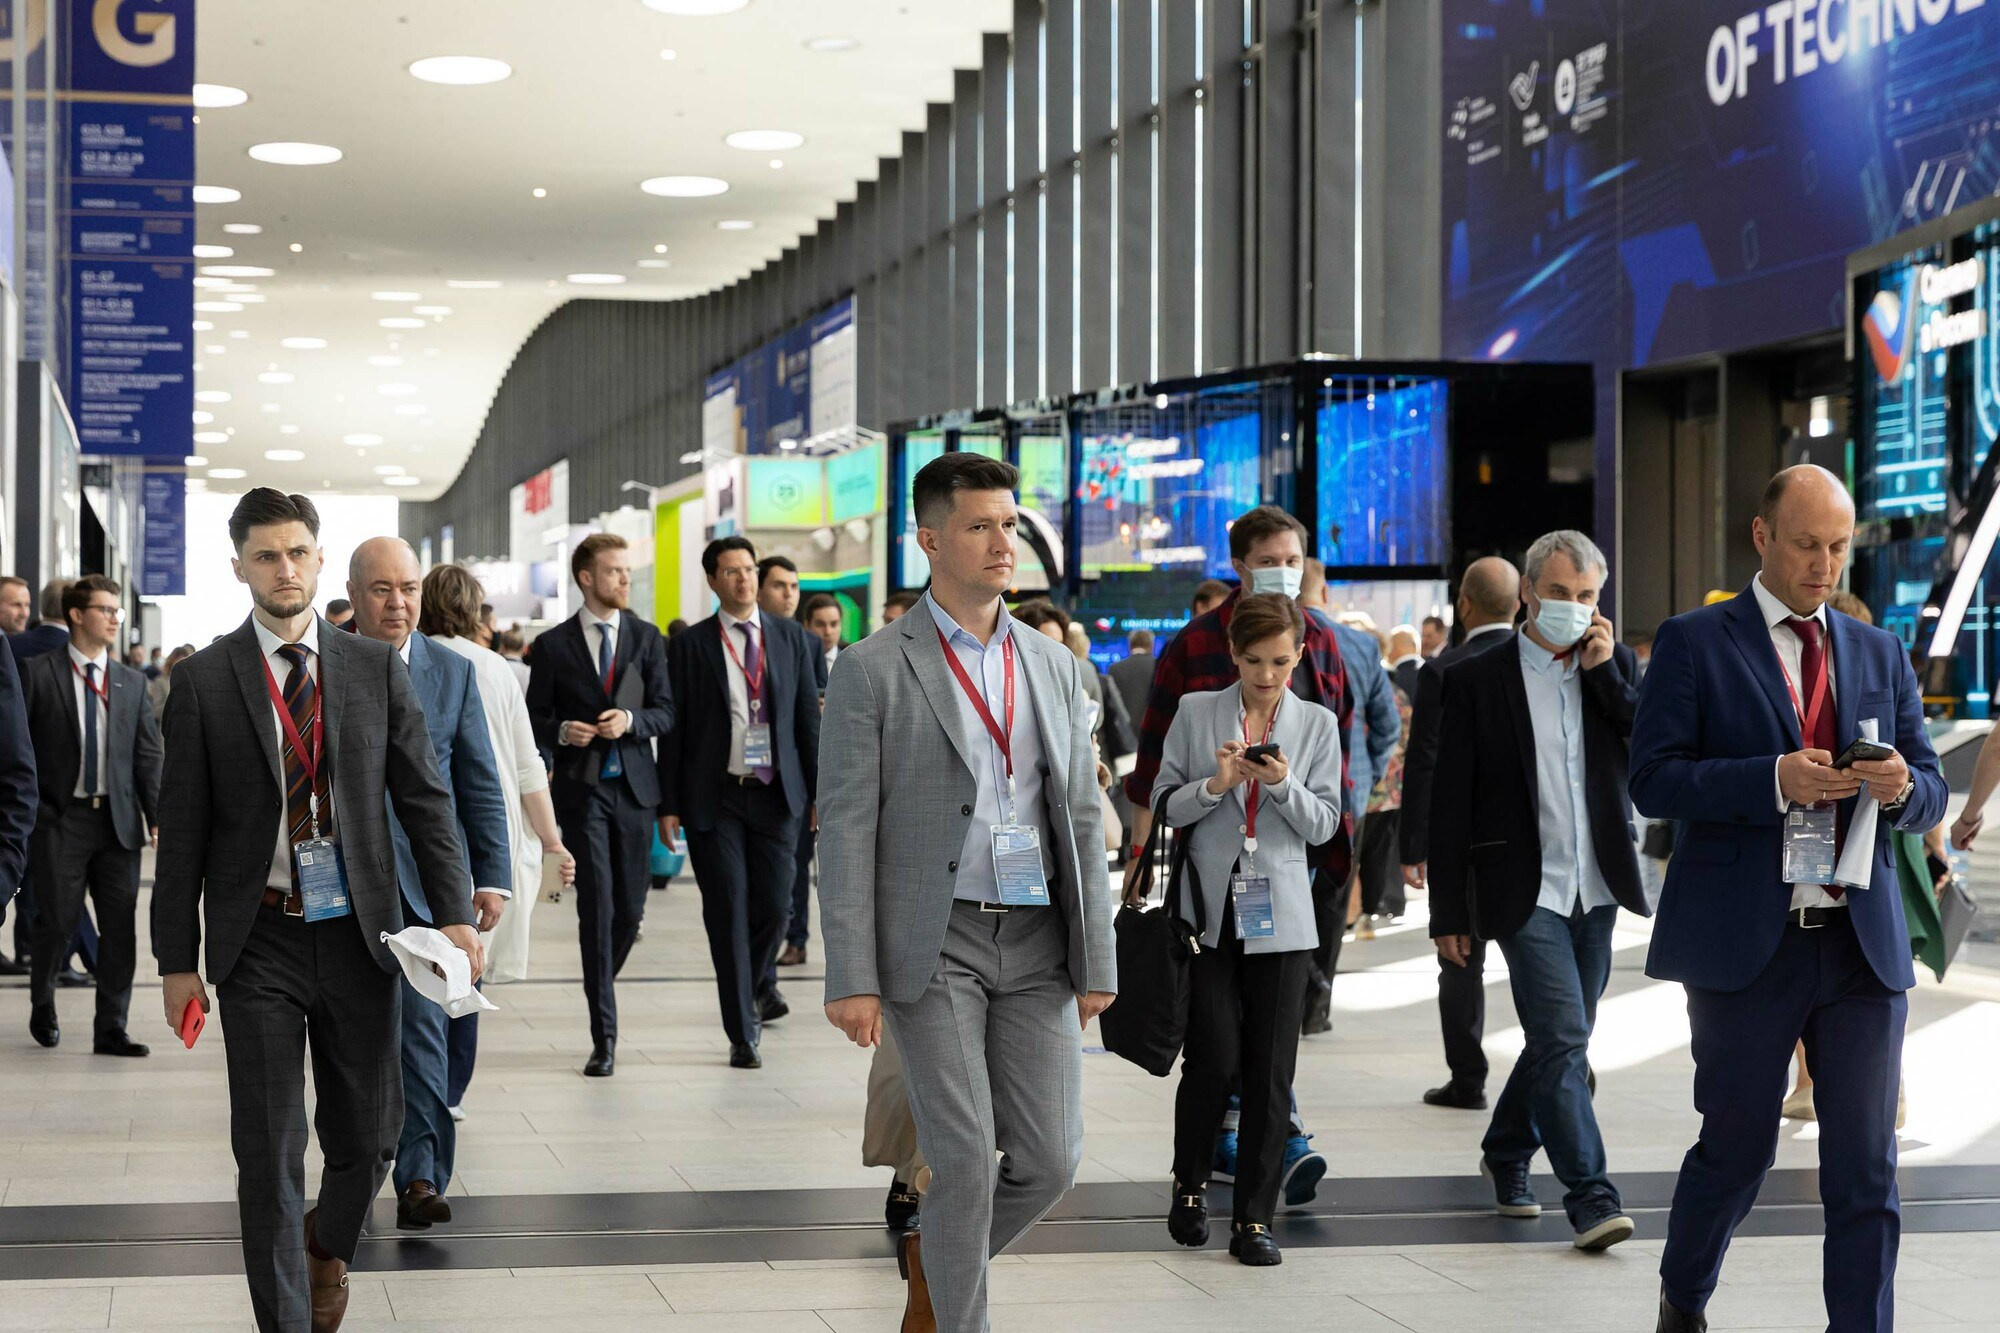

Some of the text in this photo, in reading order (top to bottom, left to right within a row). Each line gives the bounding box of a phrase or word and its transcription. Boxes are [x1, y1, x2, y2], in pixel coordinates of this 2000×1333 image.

[91, 0, 176, 68] G
[1705, 11, 1761, 107] OF
[1764, 0, 1987, 85] TECHN
